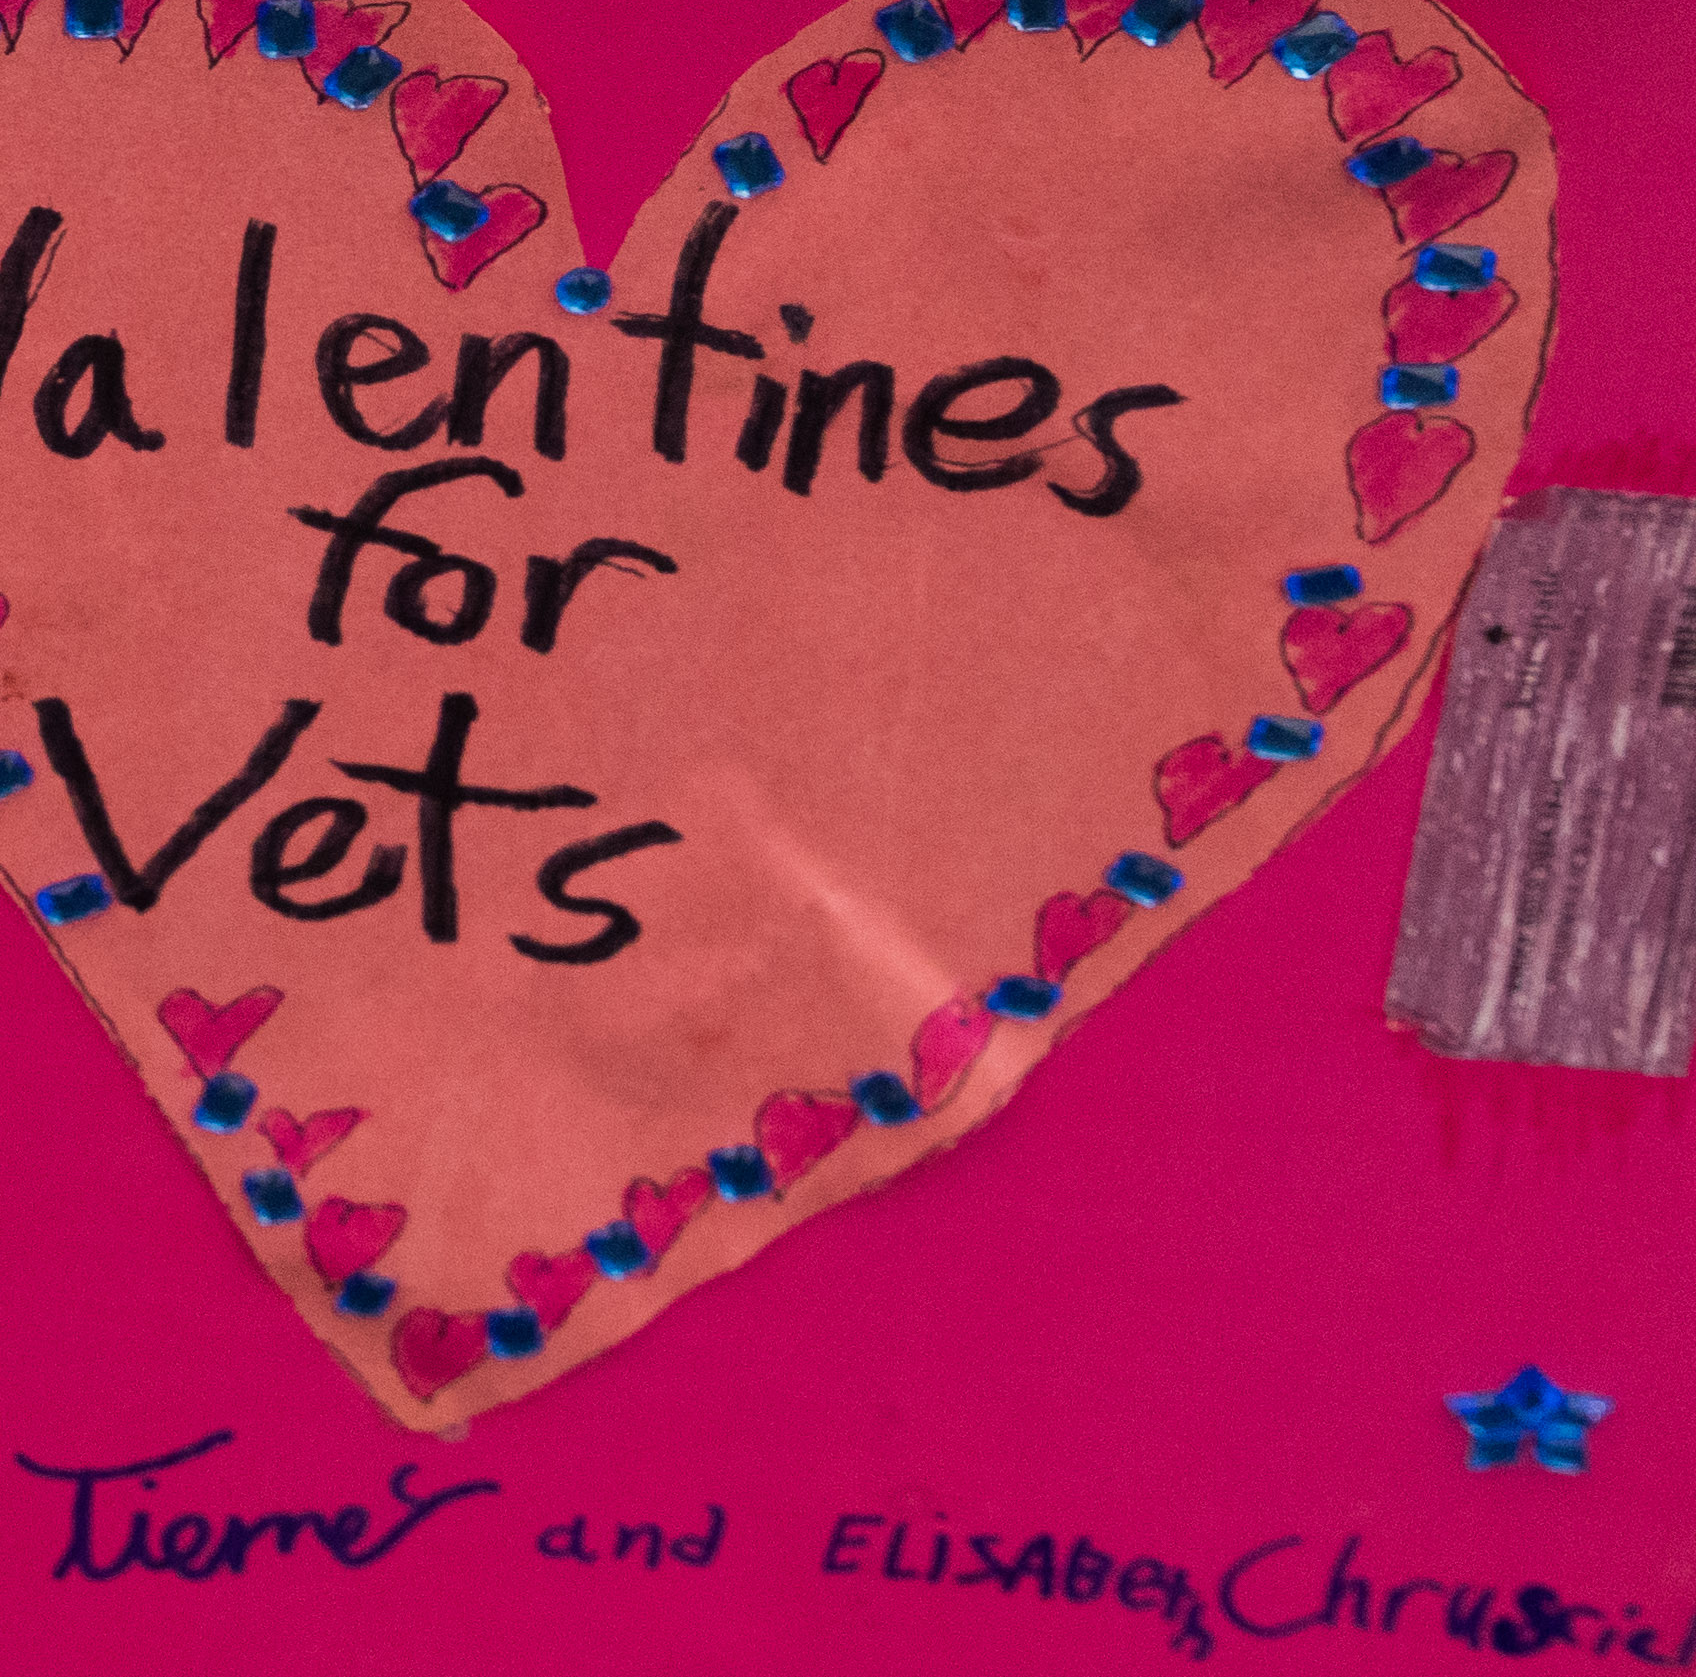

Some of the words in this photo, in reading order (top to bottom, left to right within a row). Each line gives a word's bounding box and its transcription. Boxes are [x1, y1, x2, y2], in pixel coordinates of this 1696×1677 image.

[287, 458, 677, 653] for
[33, 693, 683, 964] Vets
[536, 1503, 727, 1570] and
